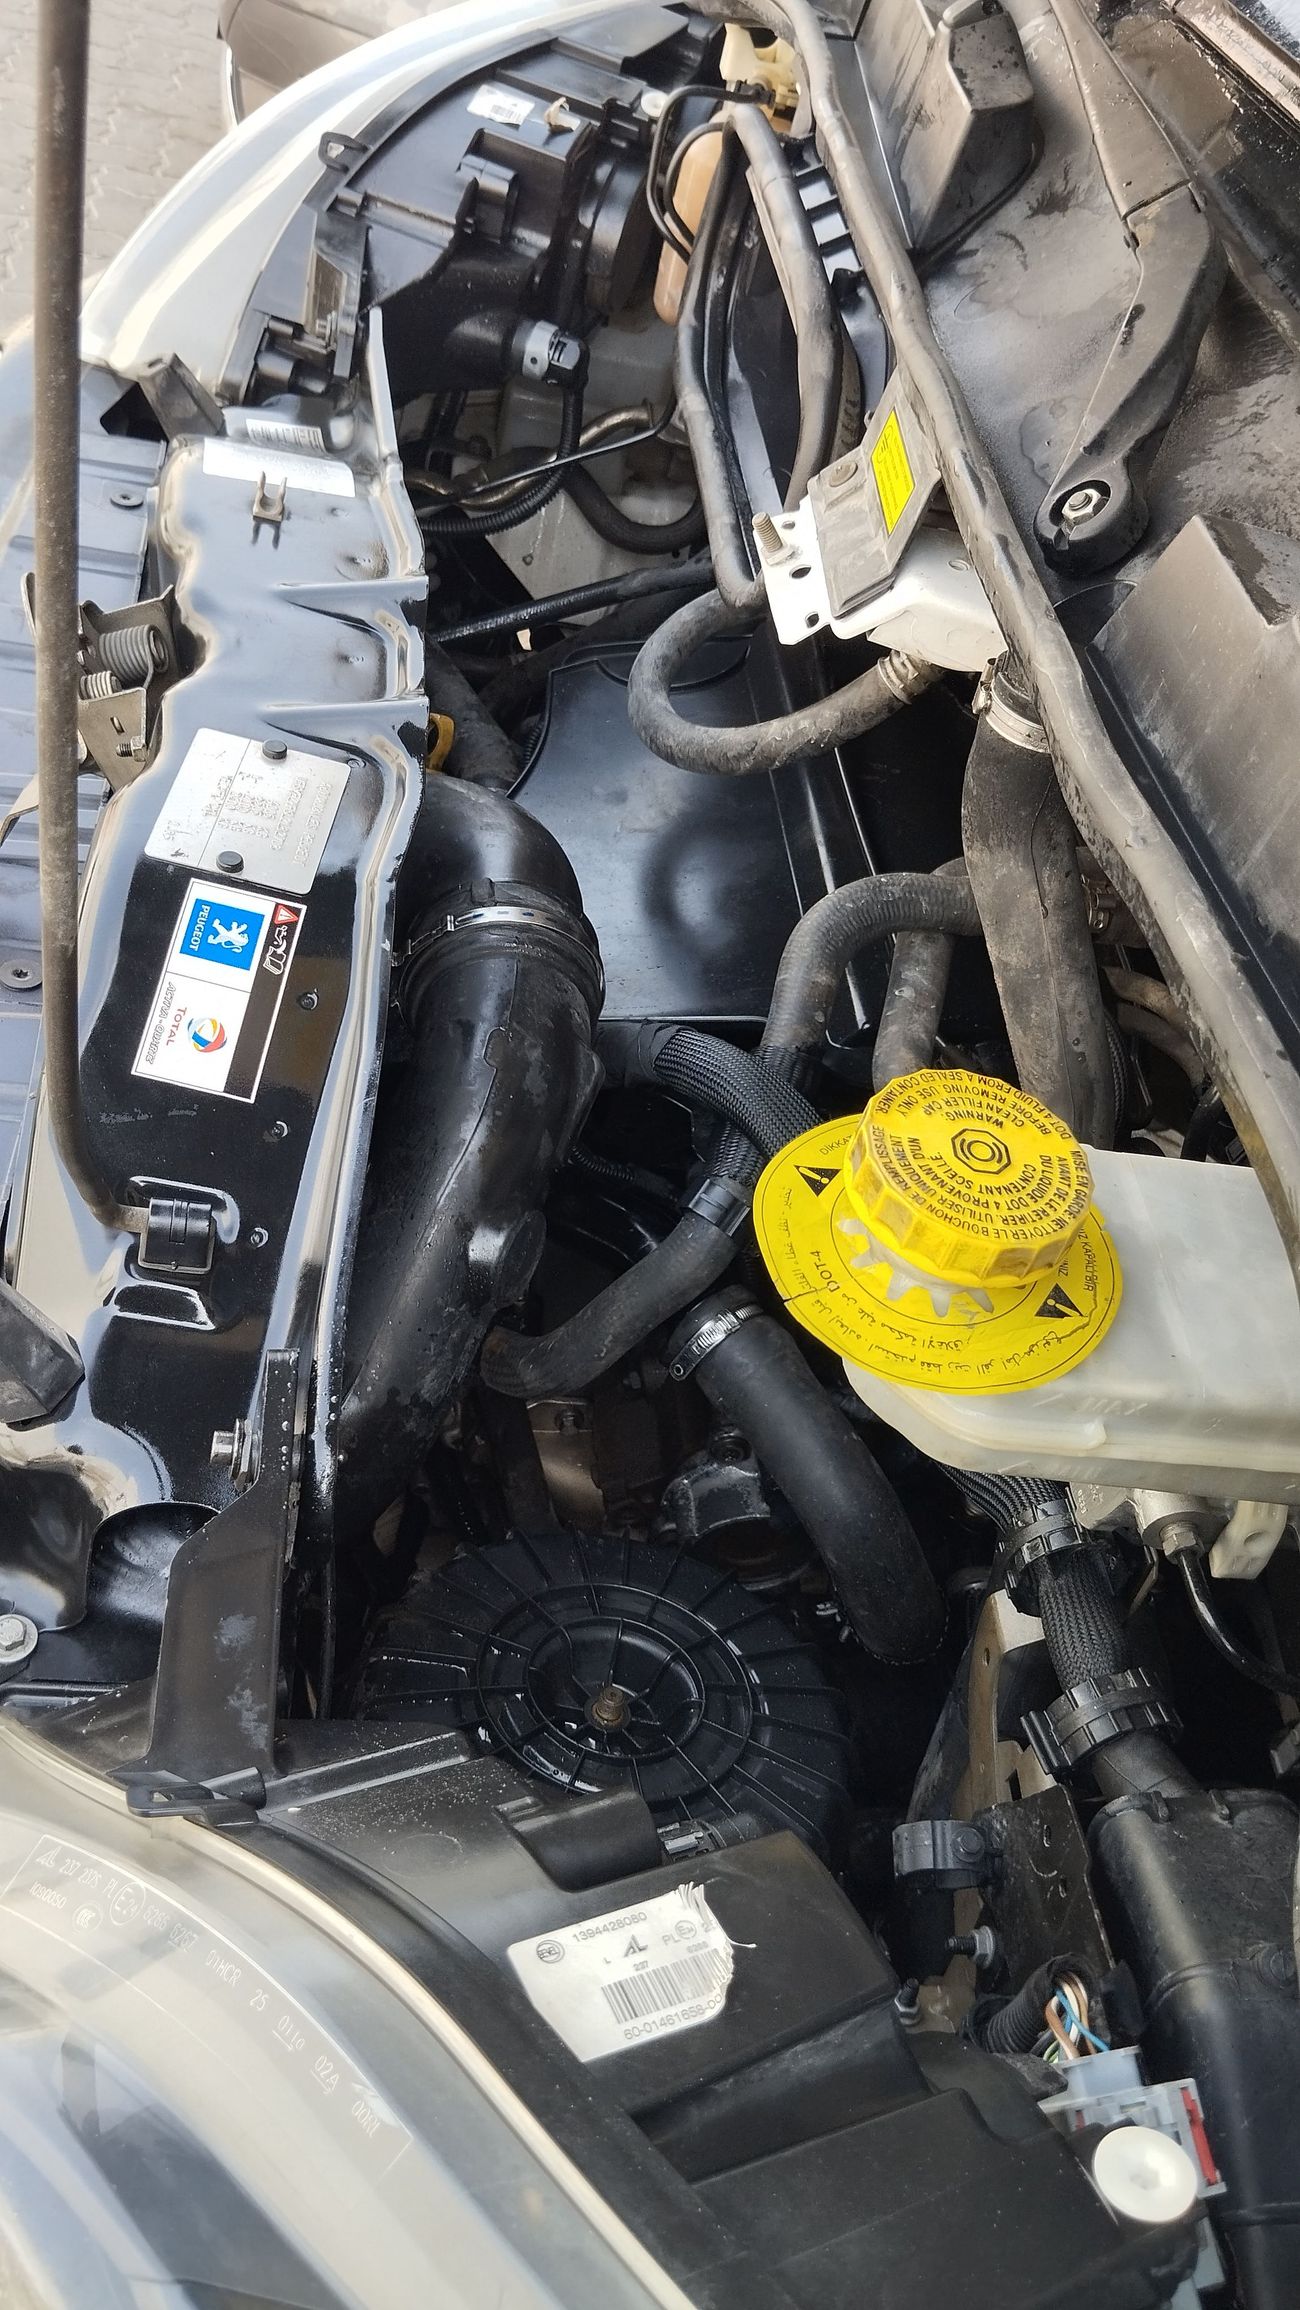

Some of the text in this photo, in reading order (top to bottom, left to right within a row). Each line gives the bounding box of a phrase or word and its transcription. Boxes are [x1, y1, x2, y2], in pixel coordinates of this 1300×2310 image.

[189, 904, 211, 952] PEUGEOT
[166, 1007, 187, 1046] TOTAL
[920, 1071, 962, 1083] SEALED
[978, 1076, 1011, 1093] FROM
[915, 1086, 939, 1099] USE
[1013, 1090, 1045, 1113] FLUID
[894, 1095, 917, 1117] ONLY
[921, 1097, 1024, 1127] CLEAN FILLER CAP
[1009, 1101, 1051, 1135] BEFORE
[1052, 1121, 1071, 1139] DOT
[872, 1125, 911, 1191] REMPLISSAGE
[890, 1134, 936, 1197] UNIQUEMENT
[1040, 1155, 1051, 1168] DU
[1071, 1151, 1087, 1172] MISE
[978, 1164, 1036, 1195] CONTENANT
[1056, 1156, 1071, 1188] AVANT
[1076, 1175, 1088, 1188] EN
[909, 1191, 926, 1205] DE
[917, 1164, 989, 1208] PROVENANT
[1026, 1170, 1053, 1203] LIQUIDE
[1053, 1187, 1068, 1202] DE
[937, 1195, 993, 1224] UTILISER
[994, 1201, 1000, 1210] 4
[1004, 1197, 1029, 1210] DOT
[1044, 1198, 1060, 1211] LE
[926, 1204, 989, 1236] BOUCHON
[1009, 1216, 1068, 1240] NETTOYER
[992, 1228, 1007, 1239] LE
[810, 1250, 839, 1292] DOT-4
[572, 1911, 648, 1943] 1394428080
[249, 1988, 270, 2012] 25
